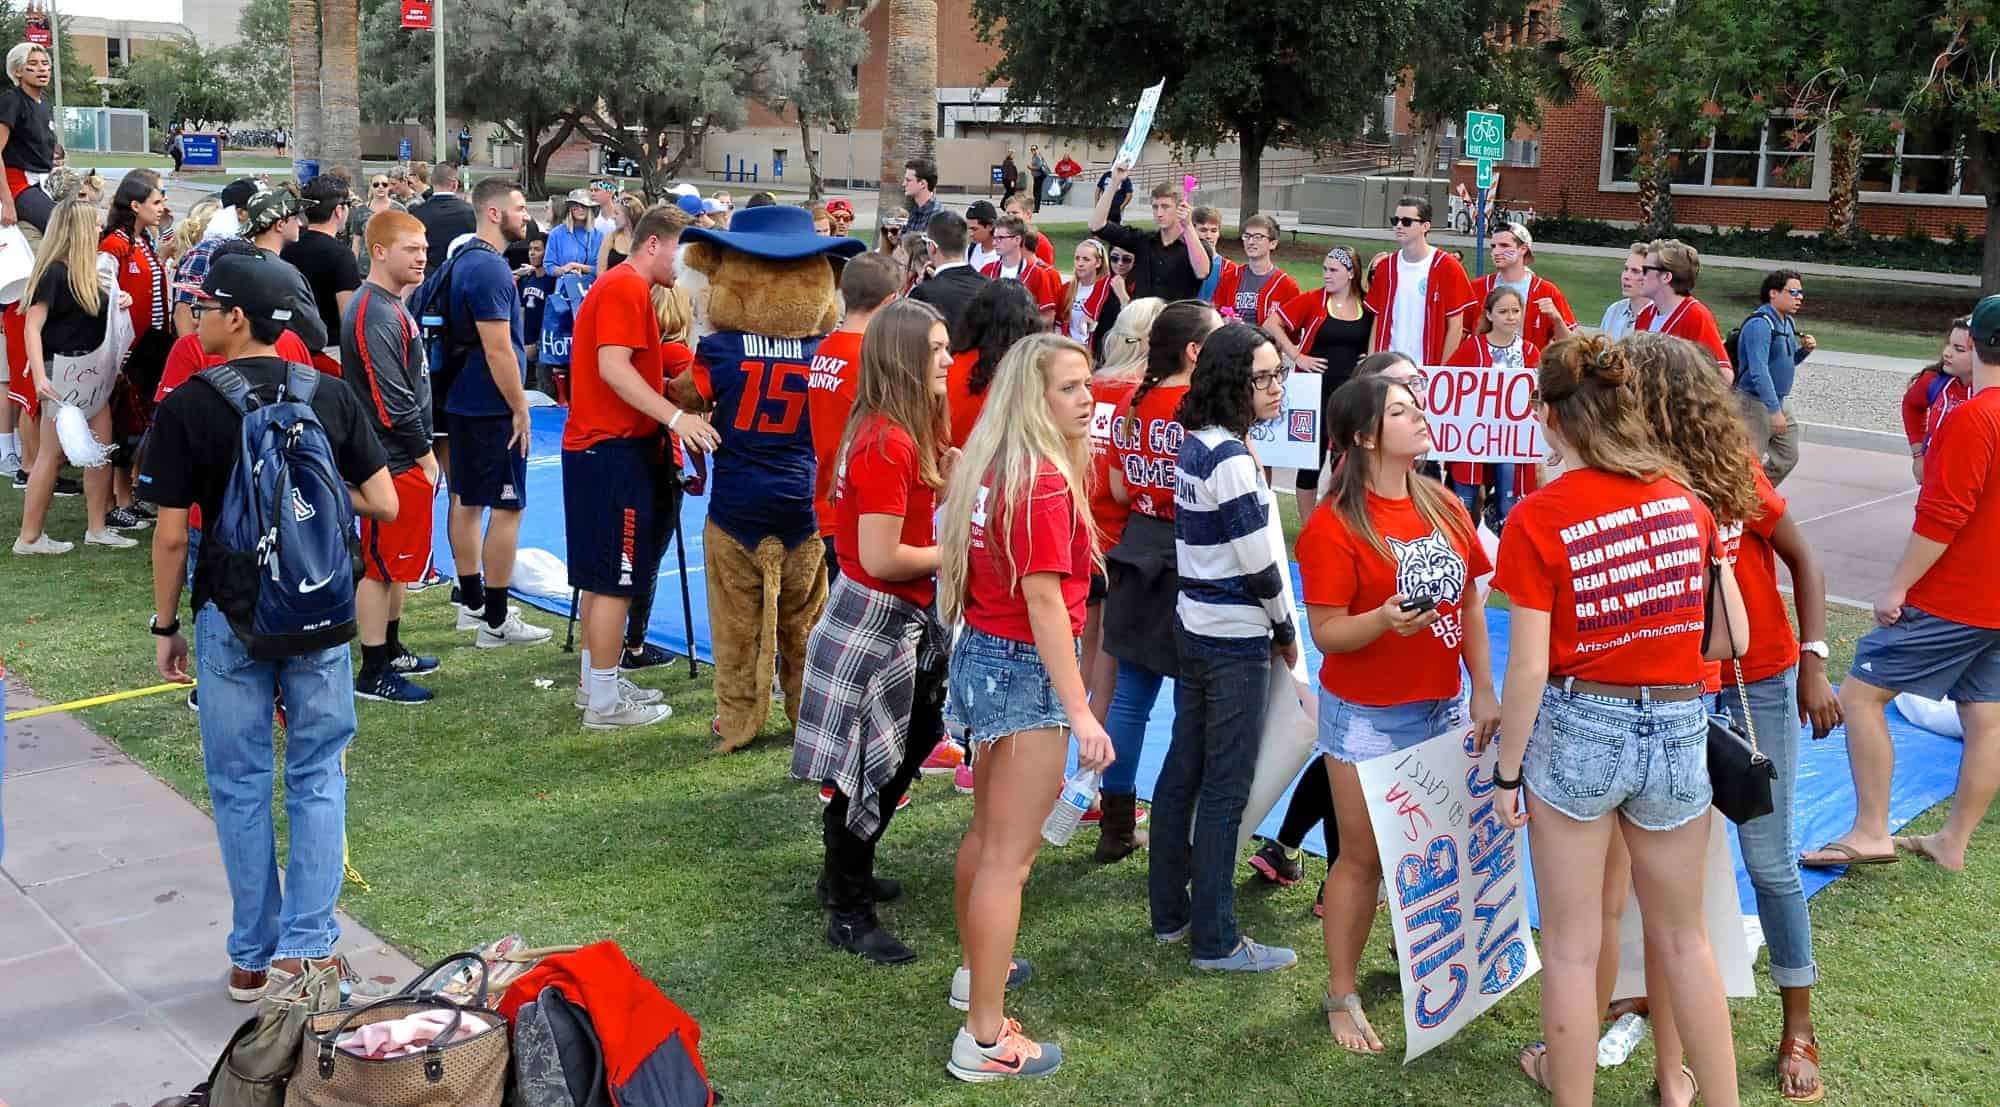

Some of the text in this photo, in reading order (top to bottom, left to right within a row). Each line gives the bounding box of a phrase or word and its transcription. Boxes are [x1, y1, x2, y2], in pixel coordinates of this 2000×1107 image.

[1469, 143, 1501, 158] BIKE ROUTE
[810, 354, 848, 375] LDCAT
[734, 360, 810, 434] 15
[1417, 368, 1542, 422] OPHO
[1427, 422, 1543, 458] ND CHILL
[1560, 519, 1598, 544] BEAR
[1596, 506, 1642, 532] DOWN,
[1569, 548, 1605, 572] BEAR
[1605, 535, 1650, 560] DOWN,
[1573, 571, 1608, 593] BEAR
[1608, 559, 1655, 584] DOWN,
[1575, 601, 1600, 618] GO,
[1600, 595, 1624, 614] GO,
[1395, 834, 1470, 1029] CUB
